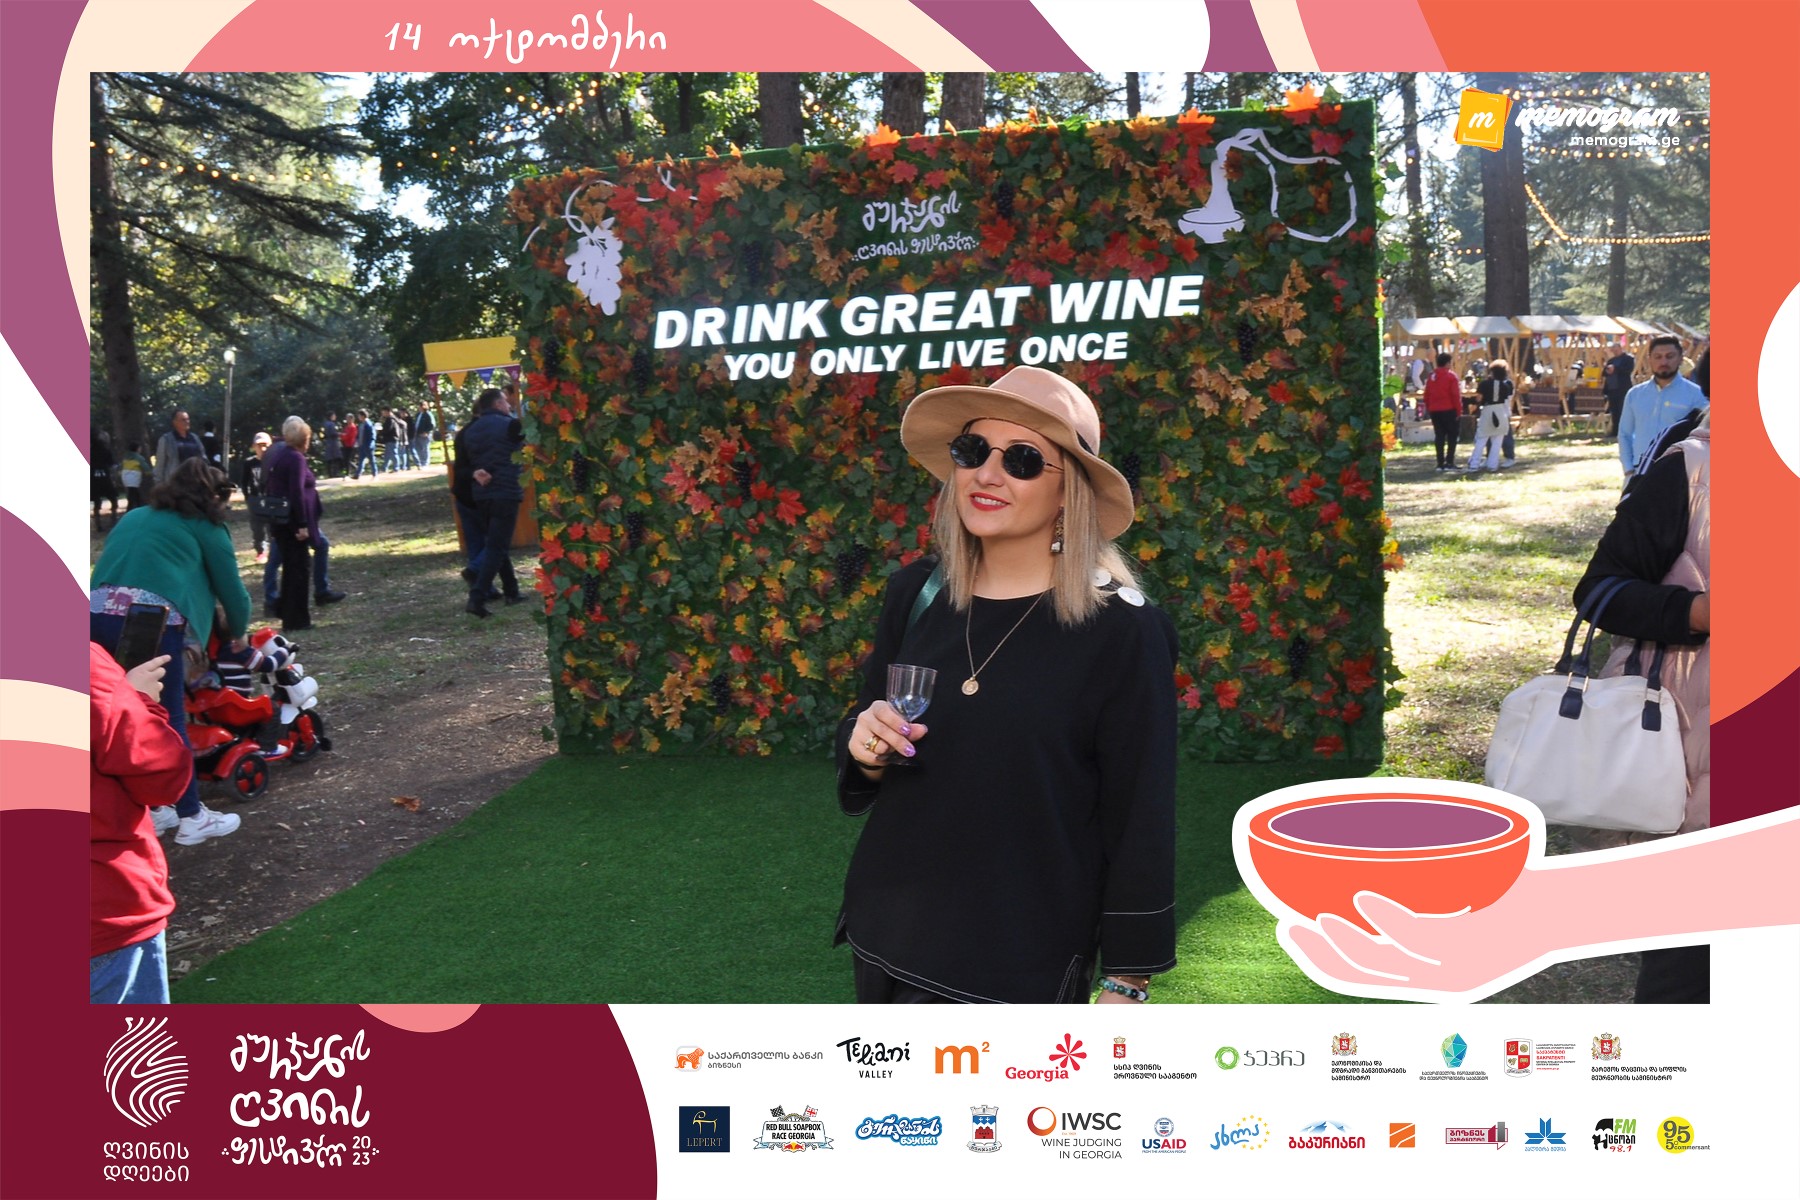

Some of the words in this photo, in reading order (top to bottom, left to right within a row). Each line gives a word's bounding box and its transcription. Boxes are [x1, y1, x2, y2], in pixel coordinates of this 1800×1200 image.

[653, 298, 830, 349] DRINK
[840, 286, 1031, 336] GREAT
[1050, 275, 1204, 324] WINE
[723, 349, 796, 381] YOU
[811, 343, 906, 376] ONLY
[919, 338, 1006, 371] LIVE
[1020, 331, 1128, 365] ONCE
